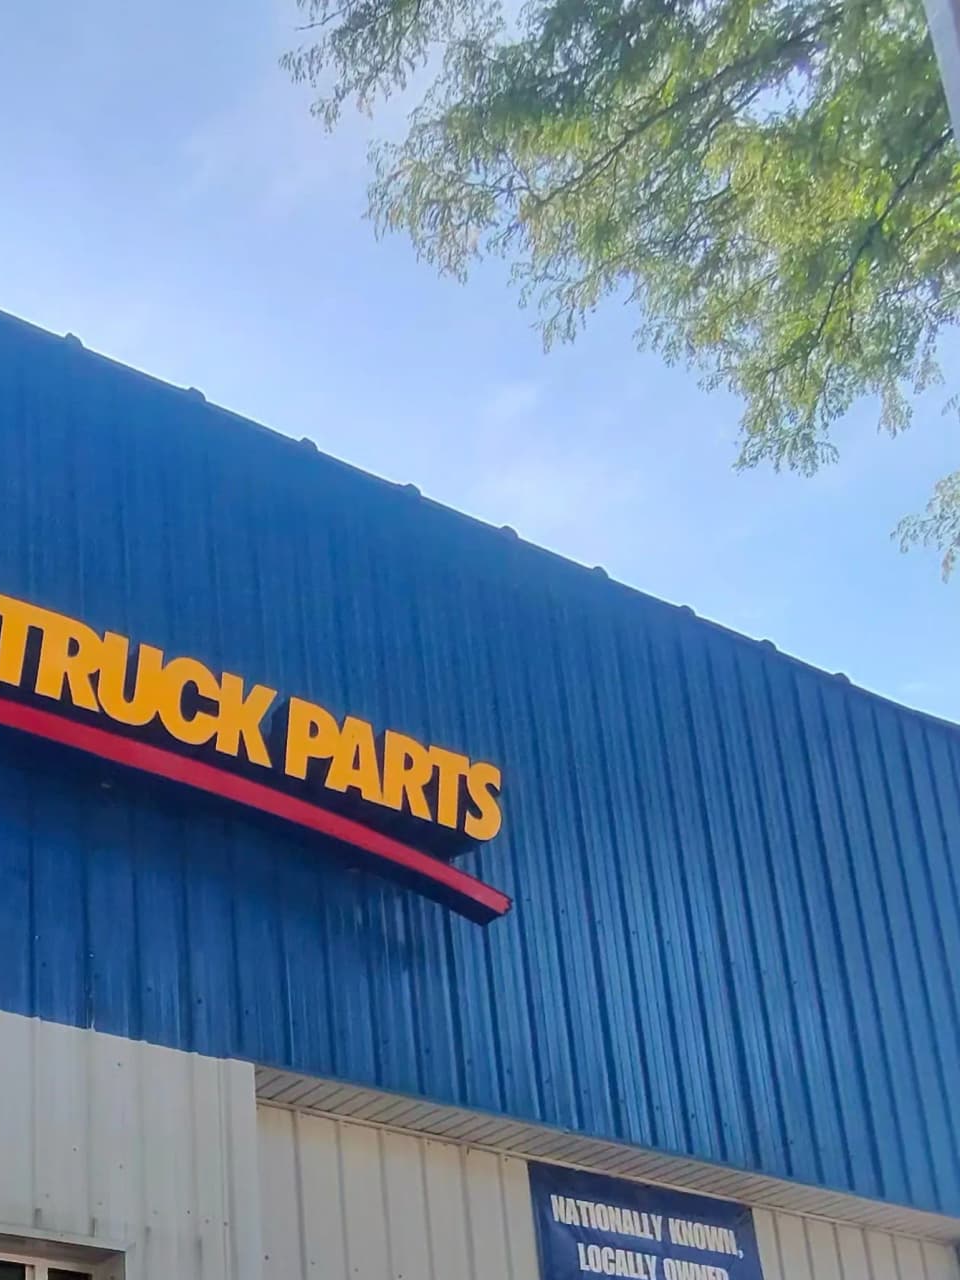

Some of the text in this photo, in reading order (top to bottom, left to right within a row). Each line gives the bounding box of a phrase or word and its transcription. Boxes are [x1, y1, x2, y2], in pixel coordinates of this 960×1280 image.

[285, 697, 502, 842] PARTS
[550, 1194, 744, 1259] NATIONALLY KNOWN,
